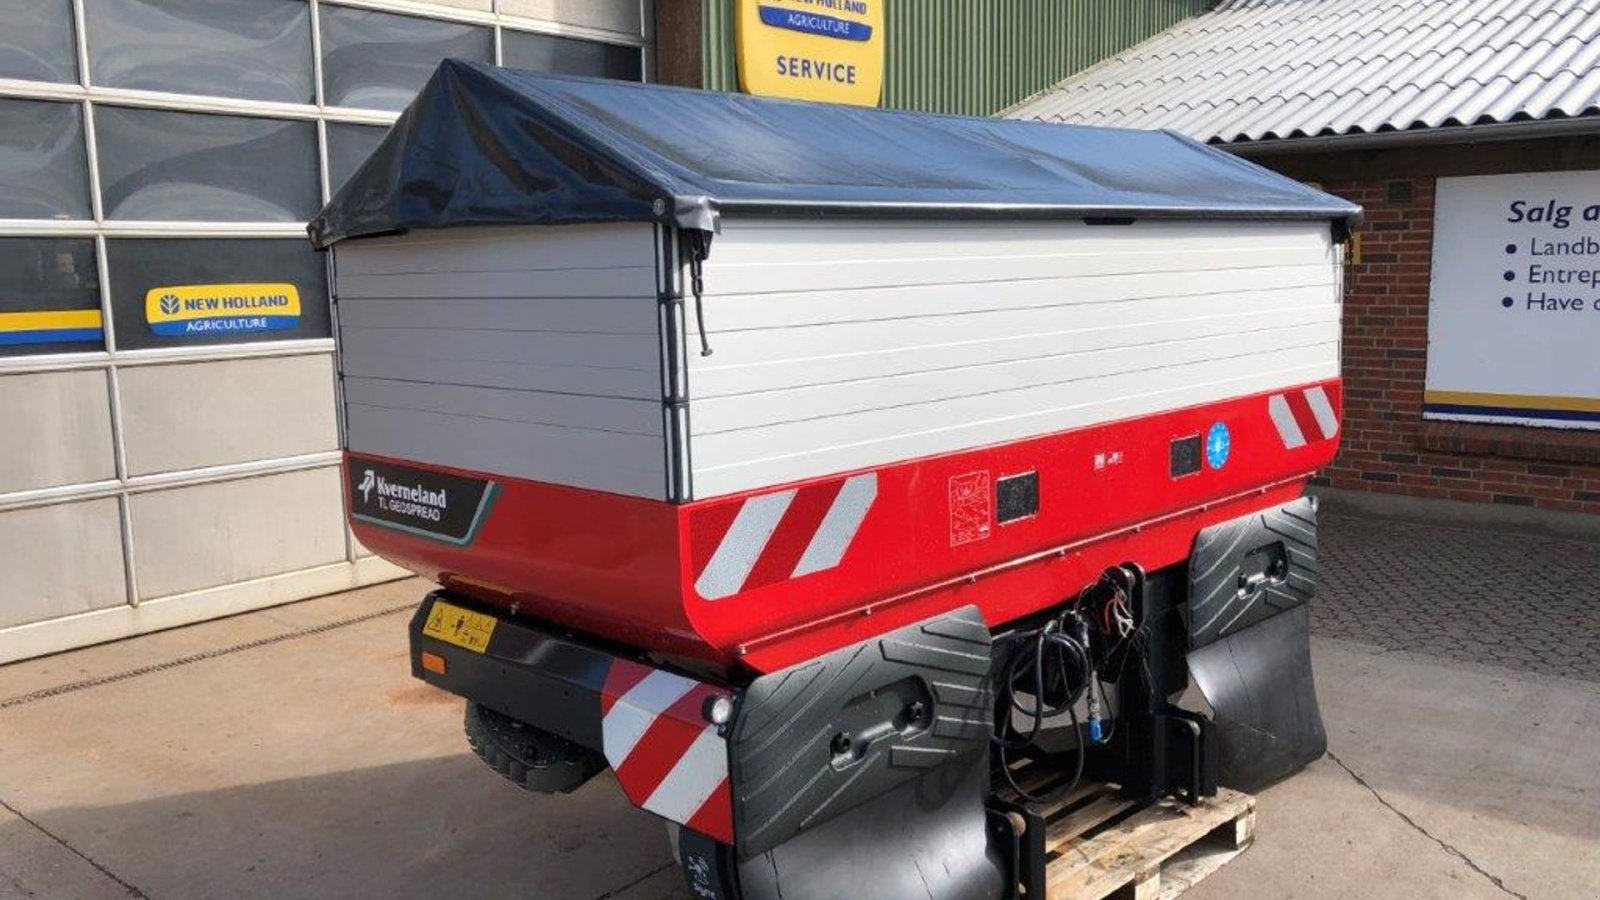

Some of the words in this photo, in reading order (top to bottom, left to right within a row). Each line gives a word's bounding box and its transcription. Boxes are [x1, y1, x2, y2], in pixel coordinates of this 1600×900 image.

[787, 13, 850, 34] AGRICULTURE
[776, 55, 856, 84] SERVICE
[1507, 199, 1573, 229] Salg
[1530, 236, 1600, 256] Landb
[1528, 264, 1600, 289] Entrep
[184, 298, 218, 310] NEW
[222, 294, 288, 308] HOLLAND
[1526, 291, 1584, 311] Have
[185, 317, 268, 332] AGRICULTURE
[376, 476, 447, 509] Kverneland
[378, 496, 389, 510] TL
[389, 499, 441, 522] GEOSPREAD
